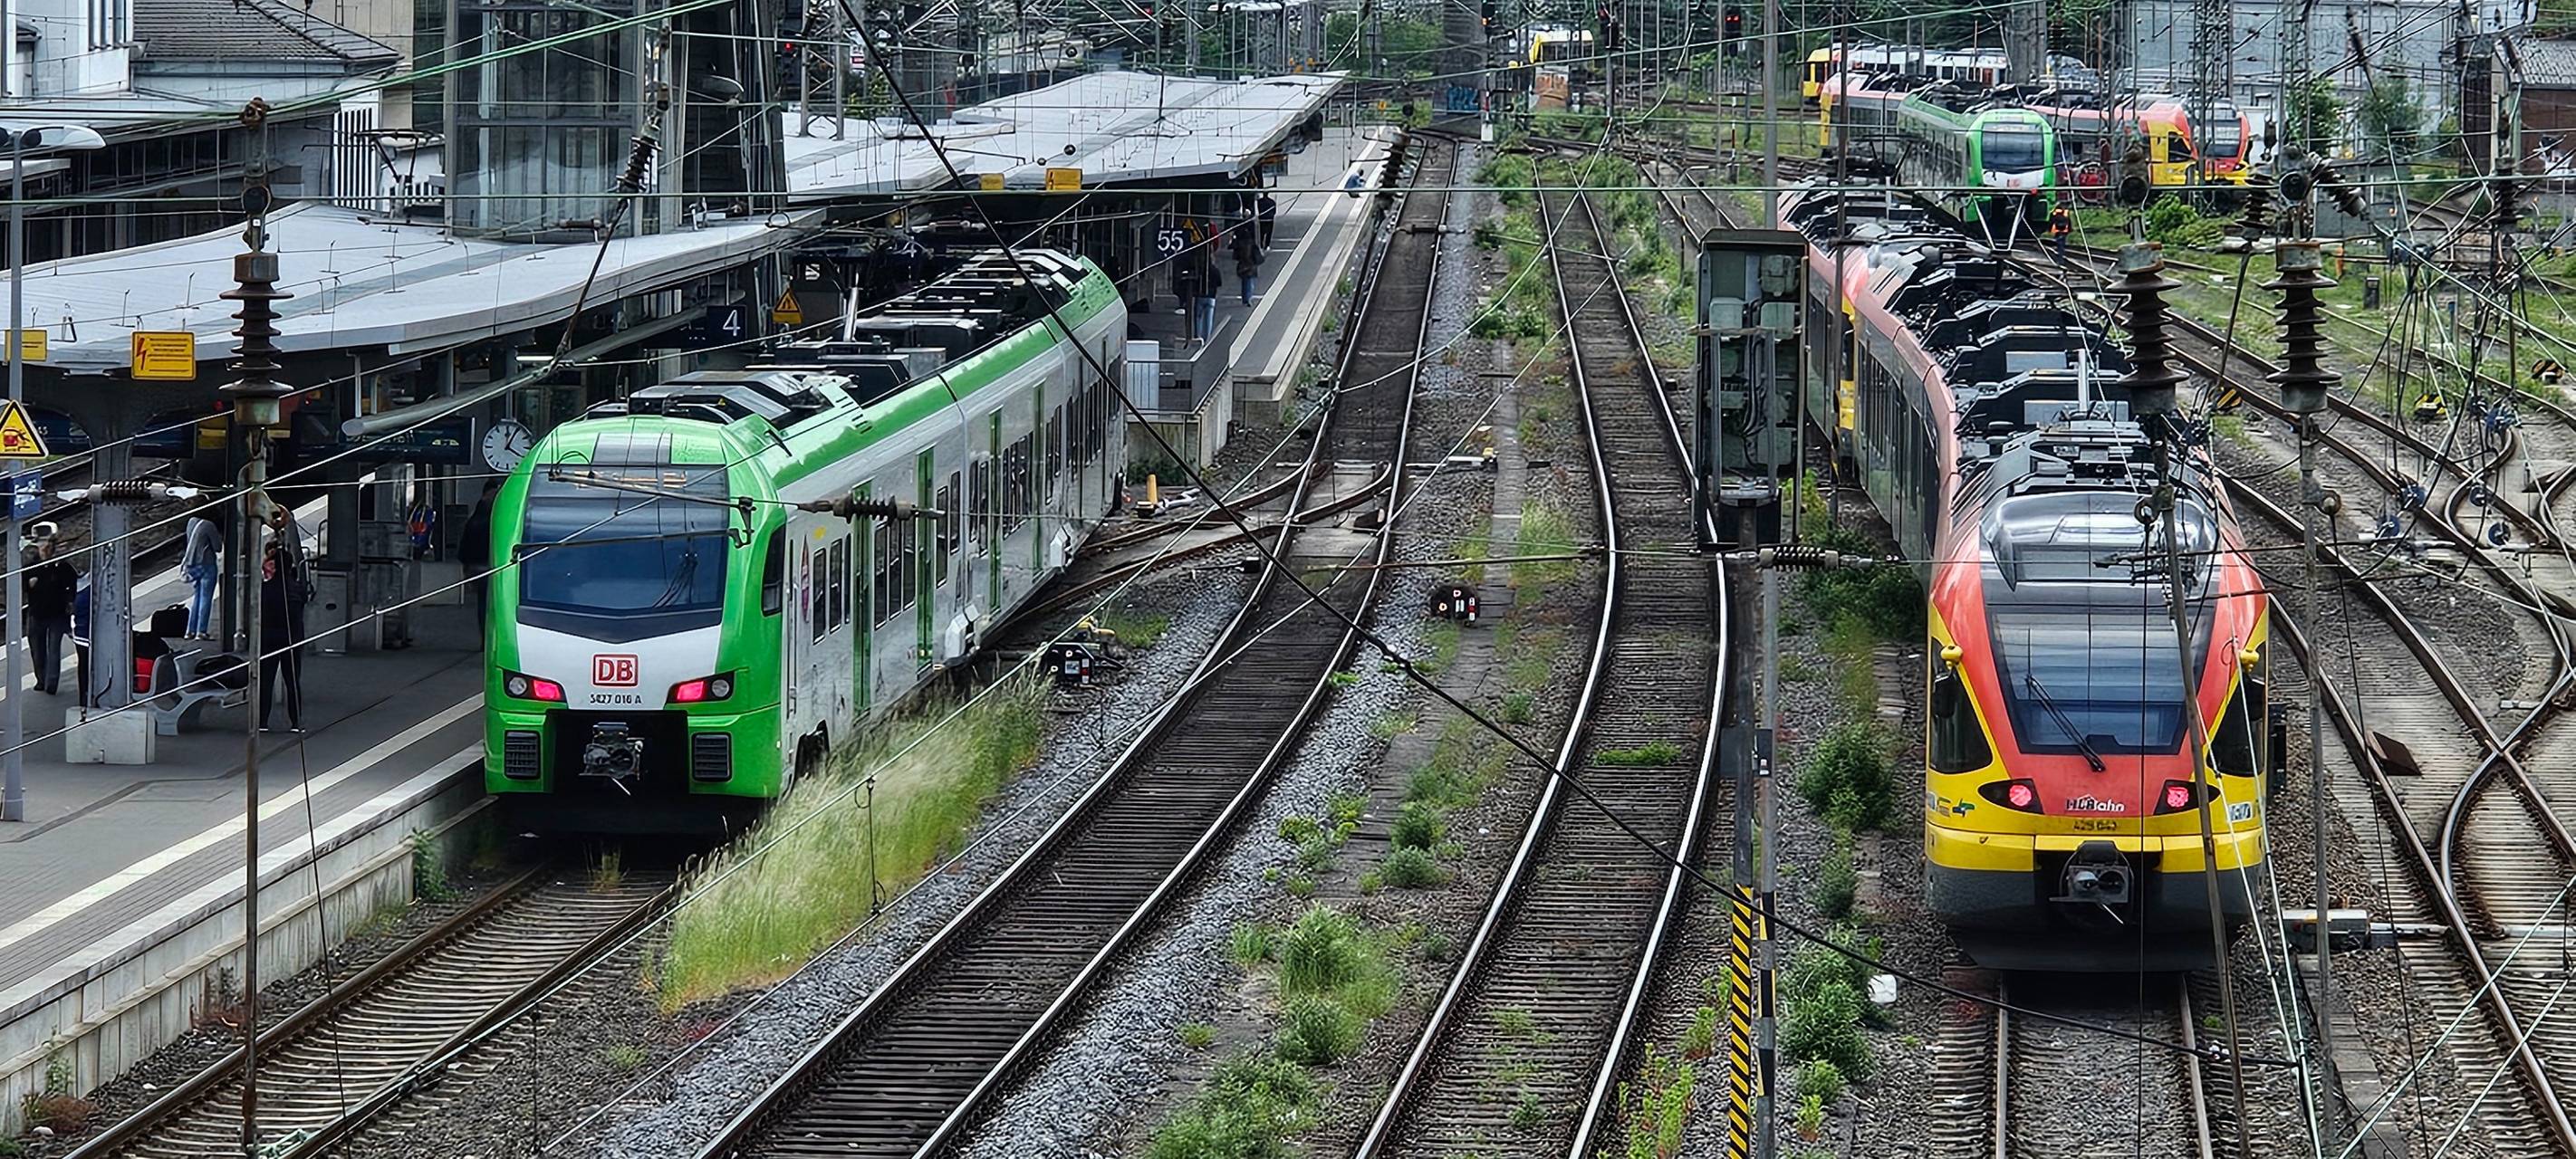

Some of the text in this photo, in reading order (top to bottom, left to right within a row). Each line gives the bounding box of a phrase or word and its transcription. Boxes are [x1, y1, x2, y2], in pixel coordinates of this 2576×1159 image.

[1158, 230, 1184, 252] 55
[723, 309, 741, 337] 4
[598, 658, 634, 683] DB
[634, 694, 642, 704] A
